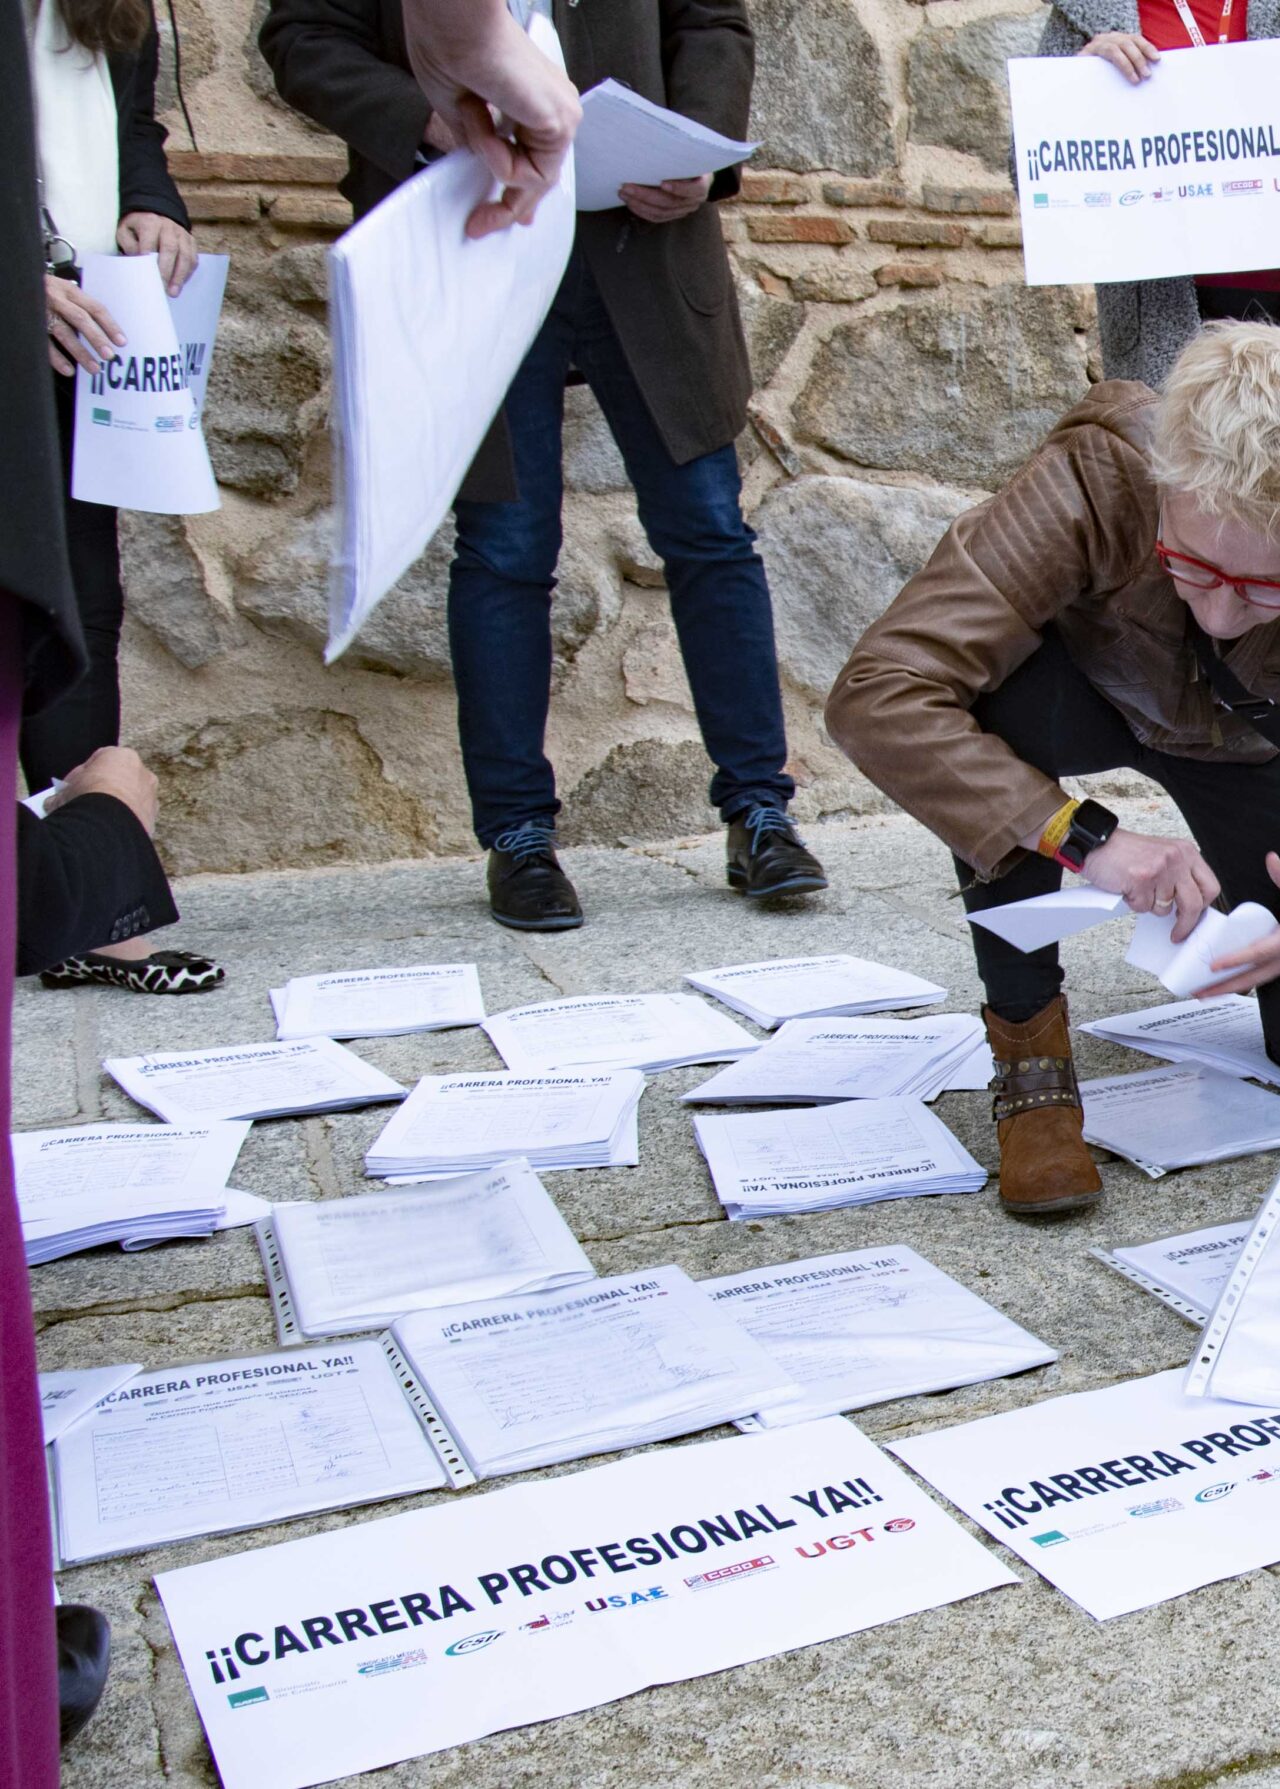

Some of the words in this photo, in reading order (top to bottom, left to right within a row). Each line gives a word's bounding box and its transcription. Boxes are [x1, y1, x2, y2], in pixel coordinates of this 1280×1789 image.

[1027, 139, 1136, 181] ¡¡CARRERA
[1141, 125, 1280, 169] PROFESIONAL
[373, 970, 442, 981] PROFESIONAL
[204, 1049, 287, 1064] PROFESIONAL
[506, 1077, 587, 1086] PROFESIONAL
[106, 1130, 185, 1140] PROFESIONAL
[742, 1184, 768, 1193] YA!!
[770, 1175, 865, 1191] PROFESIONAL
[774, 1263, 871, 1287] PROFESIONAL
[871, 1257, 900, 1269] YA!!
[441, 1311, 524, 1338] ¡¡CARRERA
[525, 1287, 630, 1320] PROFESIONAL
[630, 1280, 661, 1293] YA!!
[196, 1361, 319, 1388] PROFESIONAL
[322, 1355, 355, 1369] YA!!
[984, 1443, 1198, 1532] ¡¡CARRERA
[707, 1562, 754, 1581] CCOO
[795, 1527, 876, 1559] UGT
[205, 1584, 477, 1684] ¡¡CARRERA
[477, 1503, 798, 1605] PROFESIONAL
[790, 1477, 885, 1519] YA!!
[455, 1630, 507, 1650] CSIF
